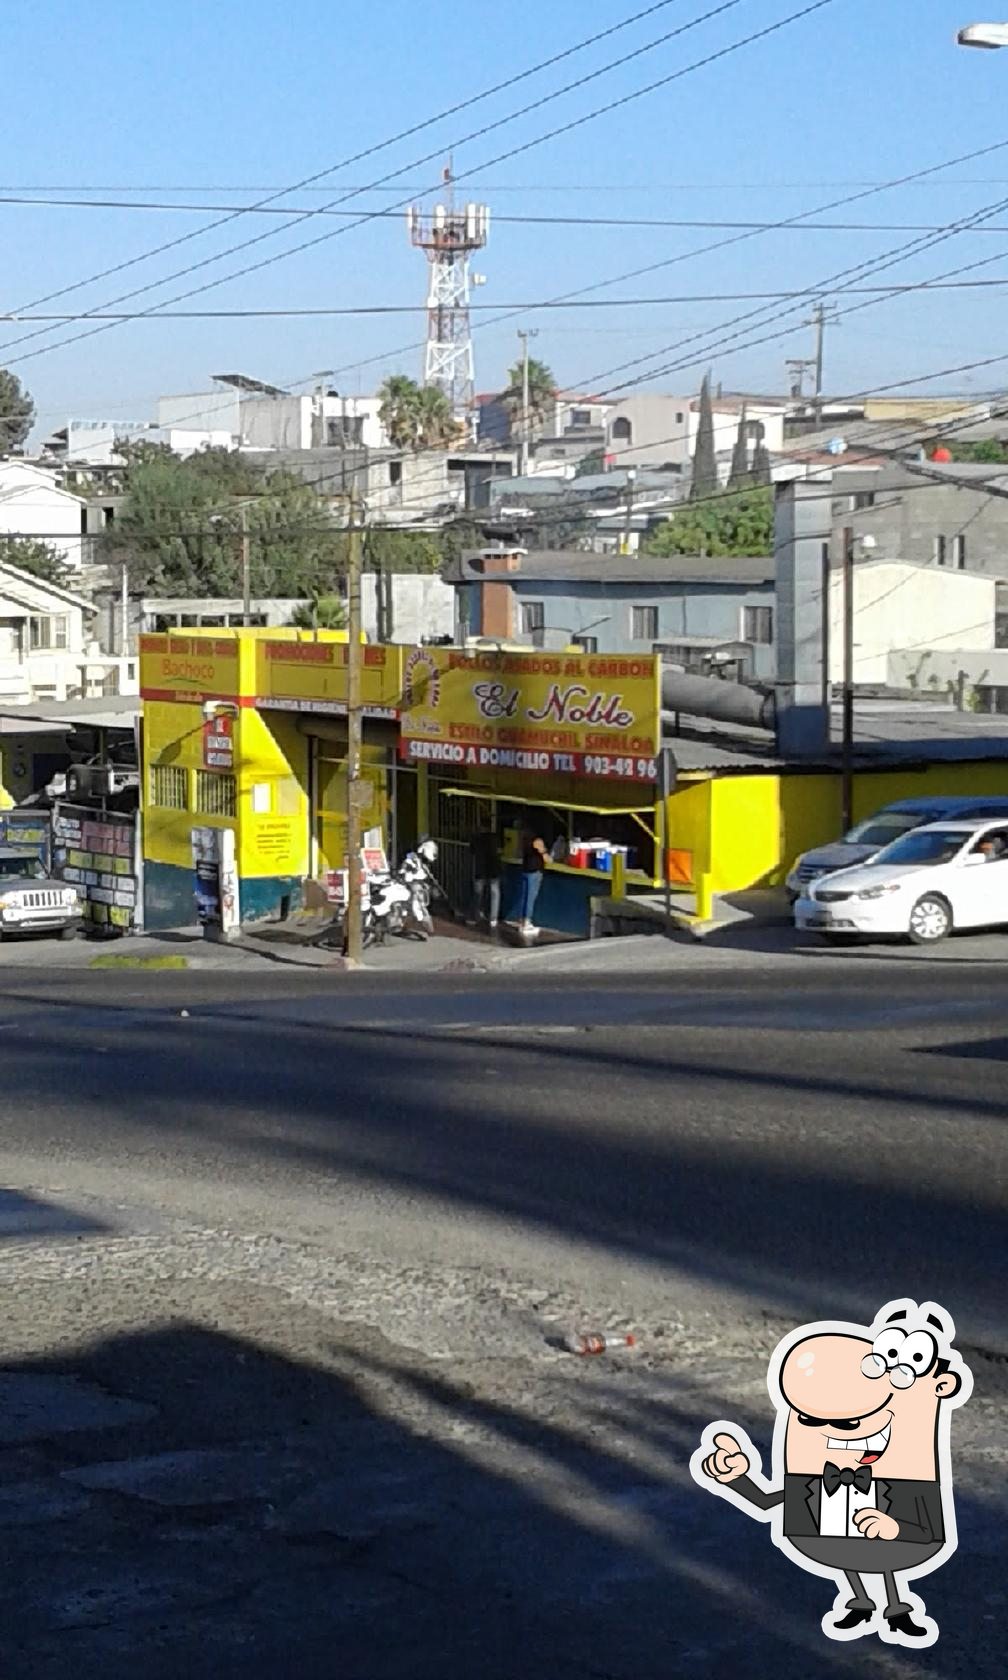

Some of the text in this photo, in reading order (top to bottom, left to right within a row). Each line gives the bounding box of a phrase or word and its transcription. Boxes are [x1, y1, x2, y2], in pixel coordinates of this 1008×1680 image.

[565, 659, 584, 677] AL
[474, 681, 521, 720] El
[528, 684, 636, 727] Noble
[410, 740, 464, 761] SERVICIO
[466, 746, 476, 764] A
[480, 748, 549, 769] DOMICILIO
[637, 759, 657, 778] 96
